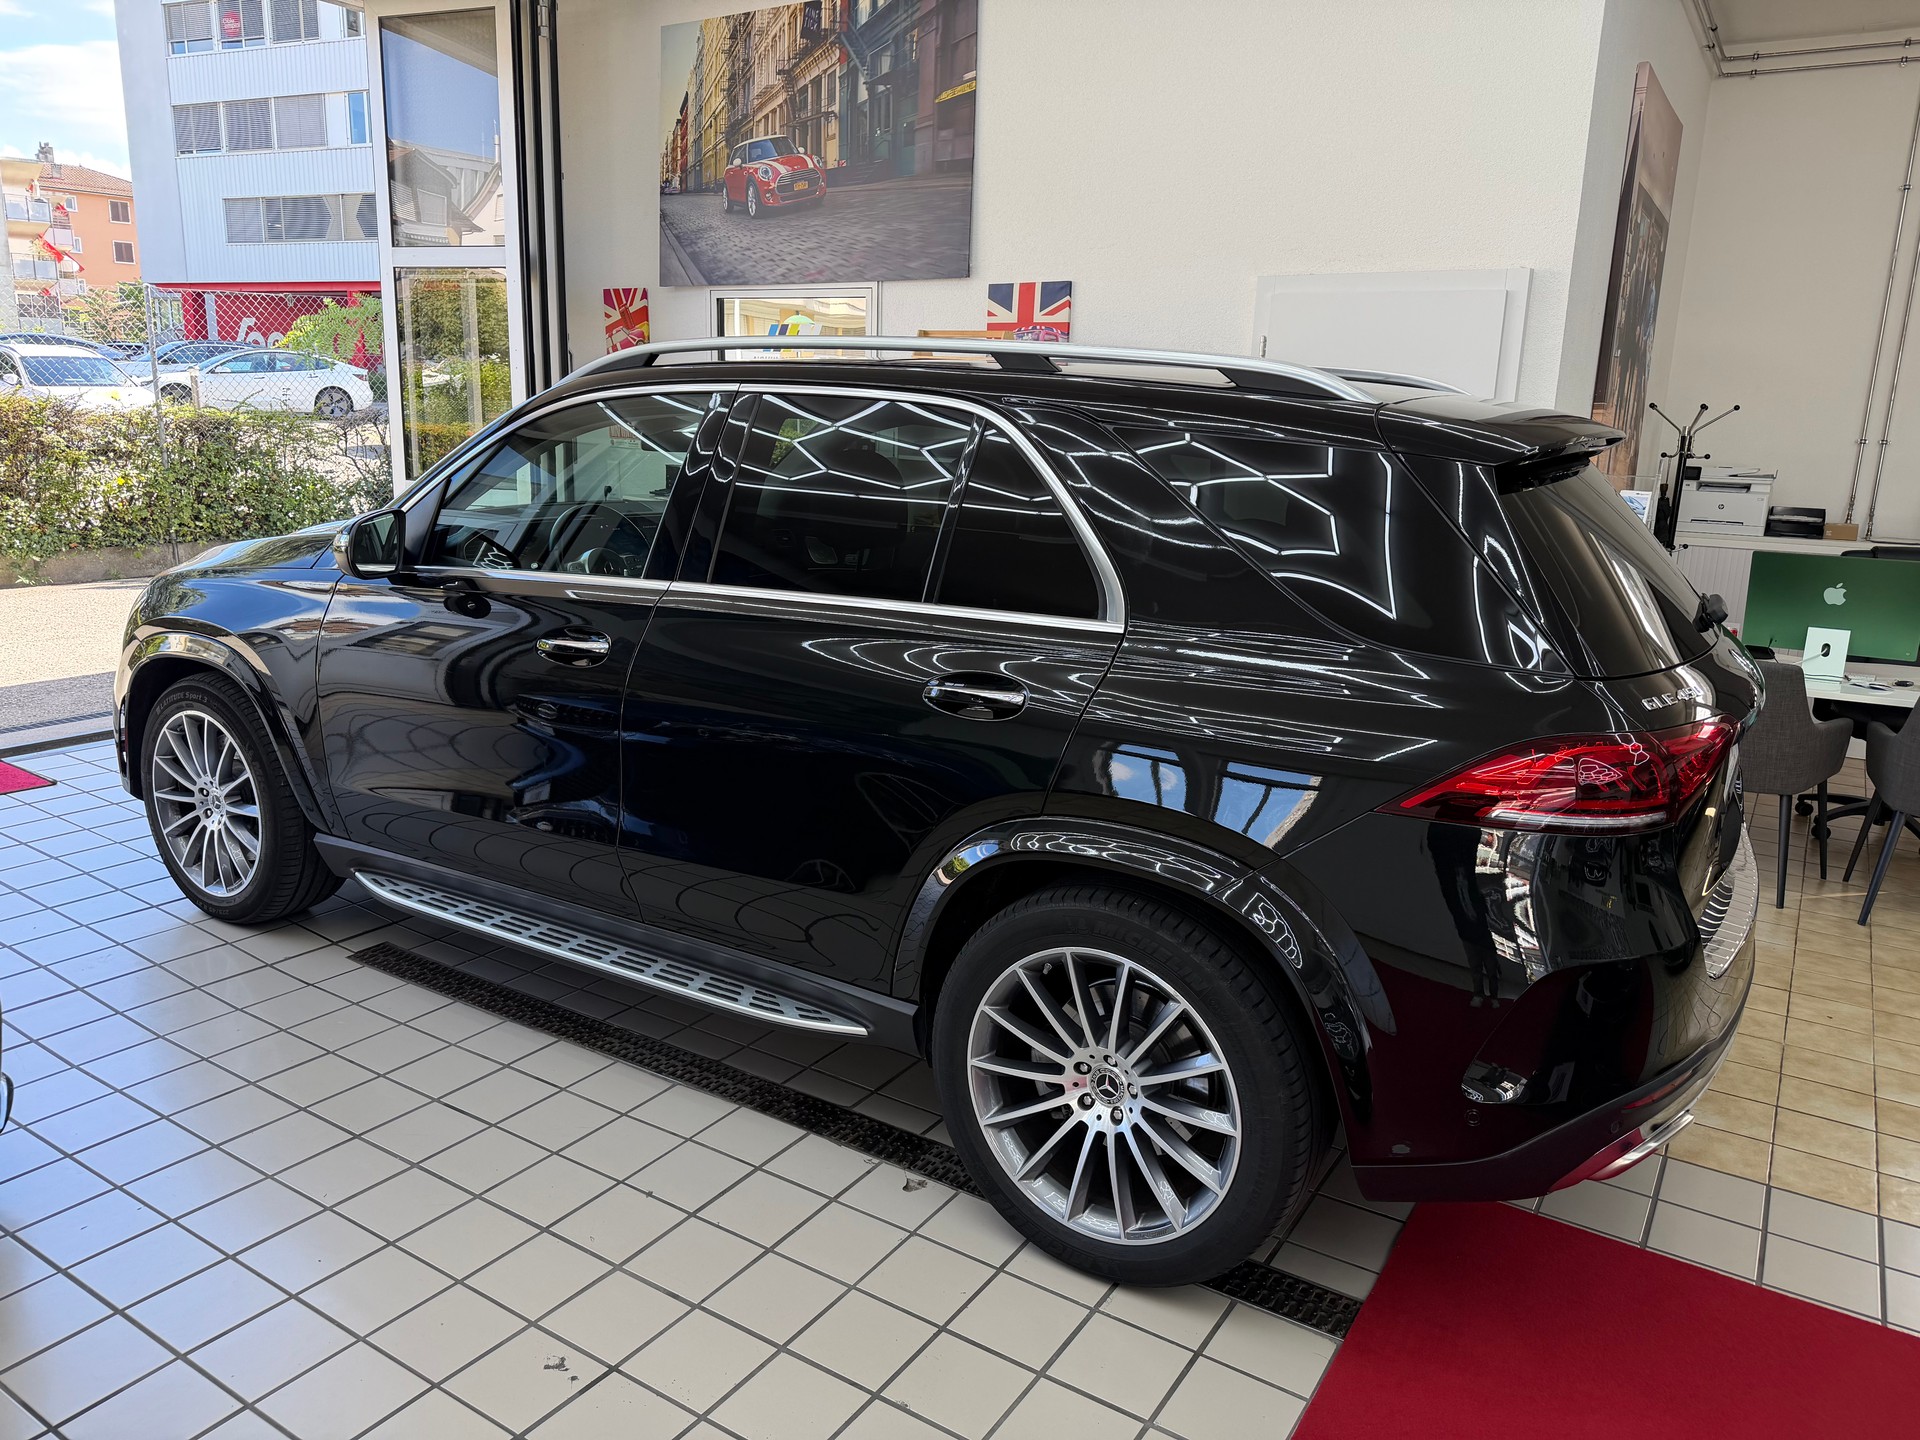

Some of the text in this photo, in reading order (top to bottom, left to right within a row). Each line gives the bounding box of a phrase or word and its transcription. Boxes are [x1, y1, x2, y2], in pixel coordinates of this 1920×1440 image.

[160, 691, 185, 709] LATITUDE
[185, 691, 202, 701] Sport
[1641, 693, 1679, 711] GLE
